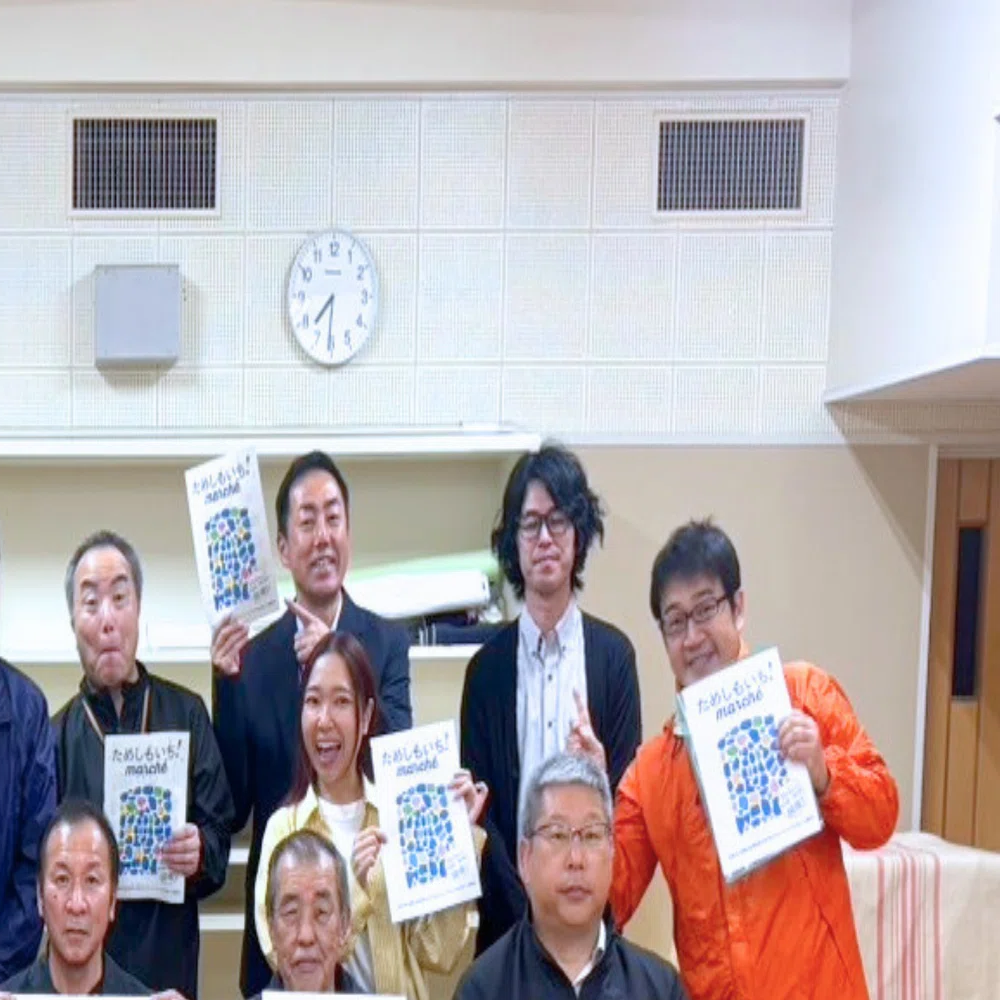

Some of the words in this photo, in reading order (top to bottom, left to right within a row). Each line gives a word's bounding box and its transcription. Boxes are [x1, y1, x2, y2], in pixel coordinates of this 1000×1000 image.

[314, 249, 322, 264] 11
[329, 241, 340, 257] 12
[302, 267, 312, 283] 10
[356, 264, 365, 281] 2
[361, 288, 368, 305] 3
[356, 313, 363, 328] 4
[314, 329, 321, 344] 7
[344, 329, 351, 345] 5
[698, 661, 773, 714] ためしもいち!
[716, 687, 764, 722] marché
[112, 739, 183, 763] ためしもいち!
[125, 758, 168, 776] marché
[396, 757, 438, 777] marché
